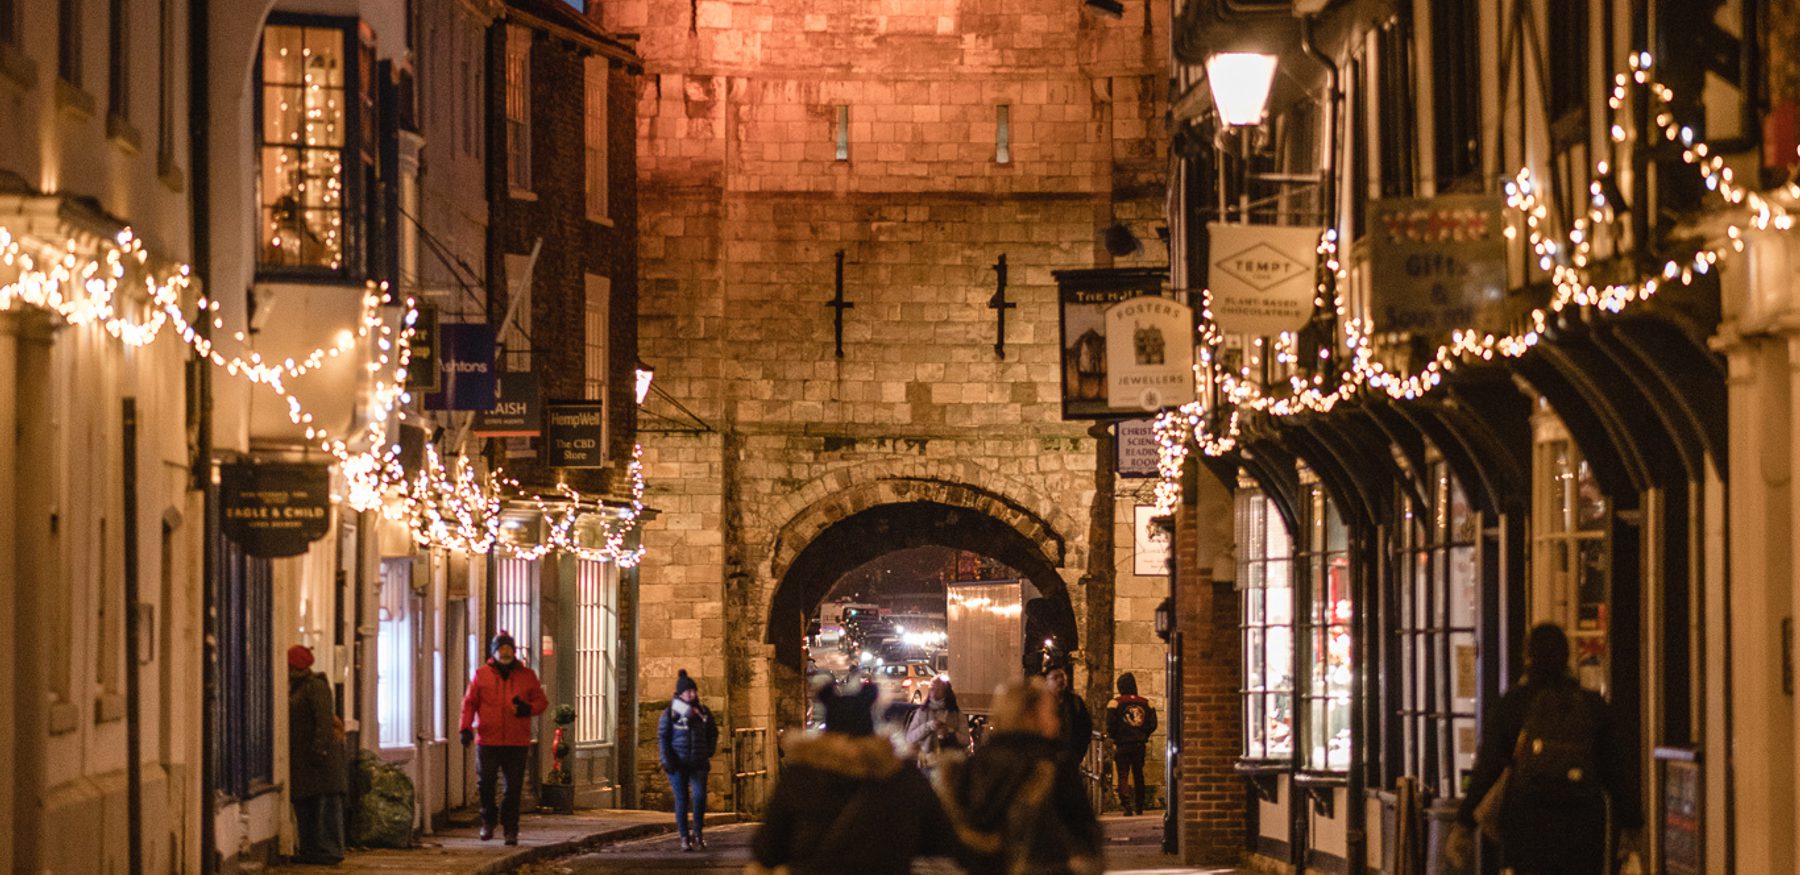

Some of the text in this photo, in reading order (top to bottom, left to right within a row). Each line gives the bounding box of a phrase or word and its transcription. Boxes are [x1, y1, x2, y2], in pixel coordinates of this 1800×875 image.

[1235, 260, 1292, 273] TEMPT
[1116, 302, 1180, 321] FOSTERS
[1118, 374, 1184, 386] JEWELLERS
[551, 411, 600, 429] HempWell
[556, 438, 596, 449] The CBD
[563, 449, 588, 460] Store
[225, 507, 269, 518] EAGLE
[283, 507, 325, 518] CHILD
